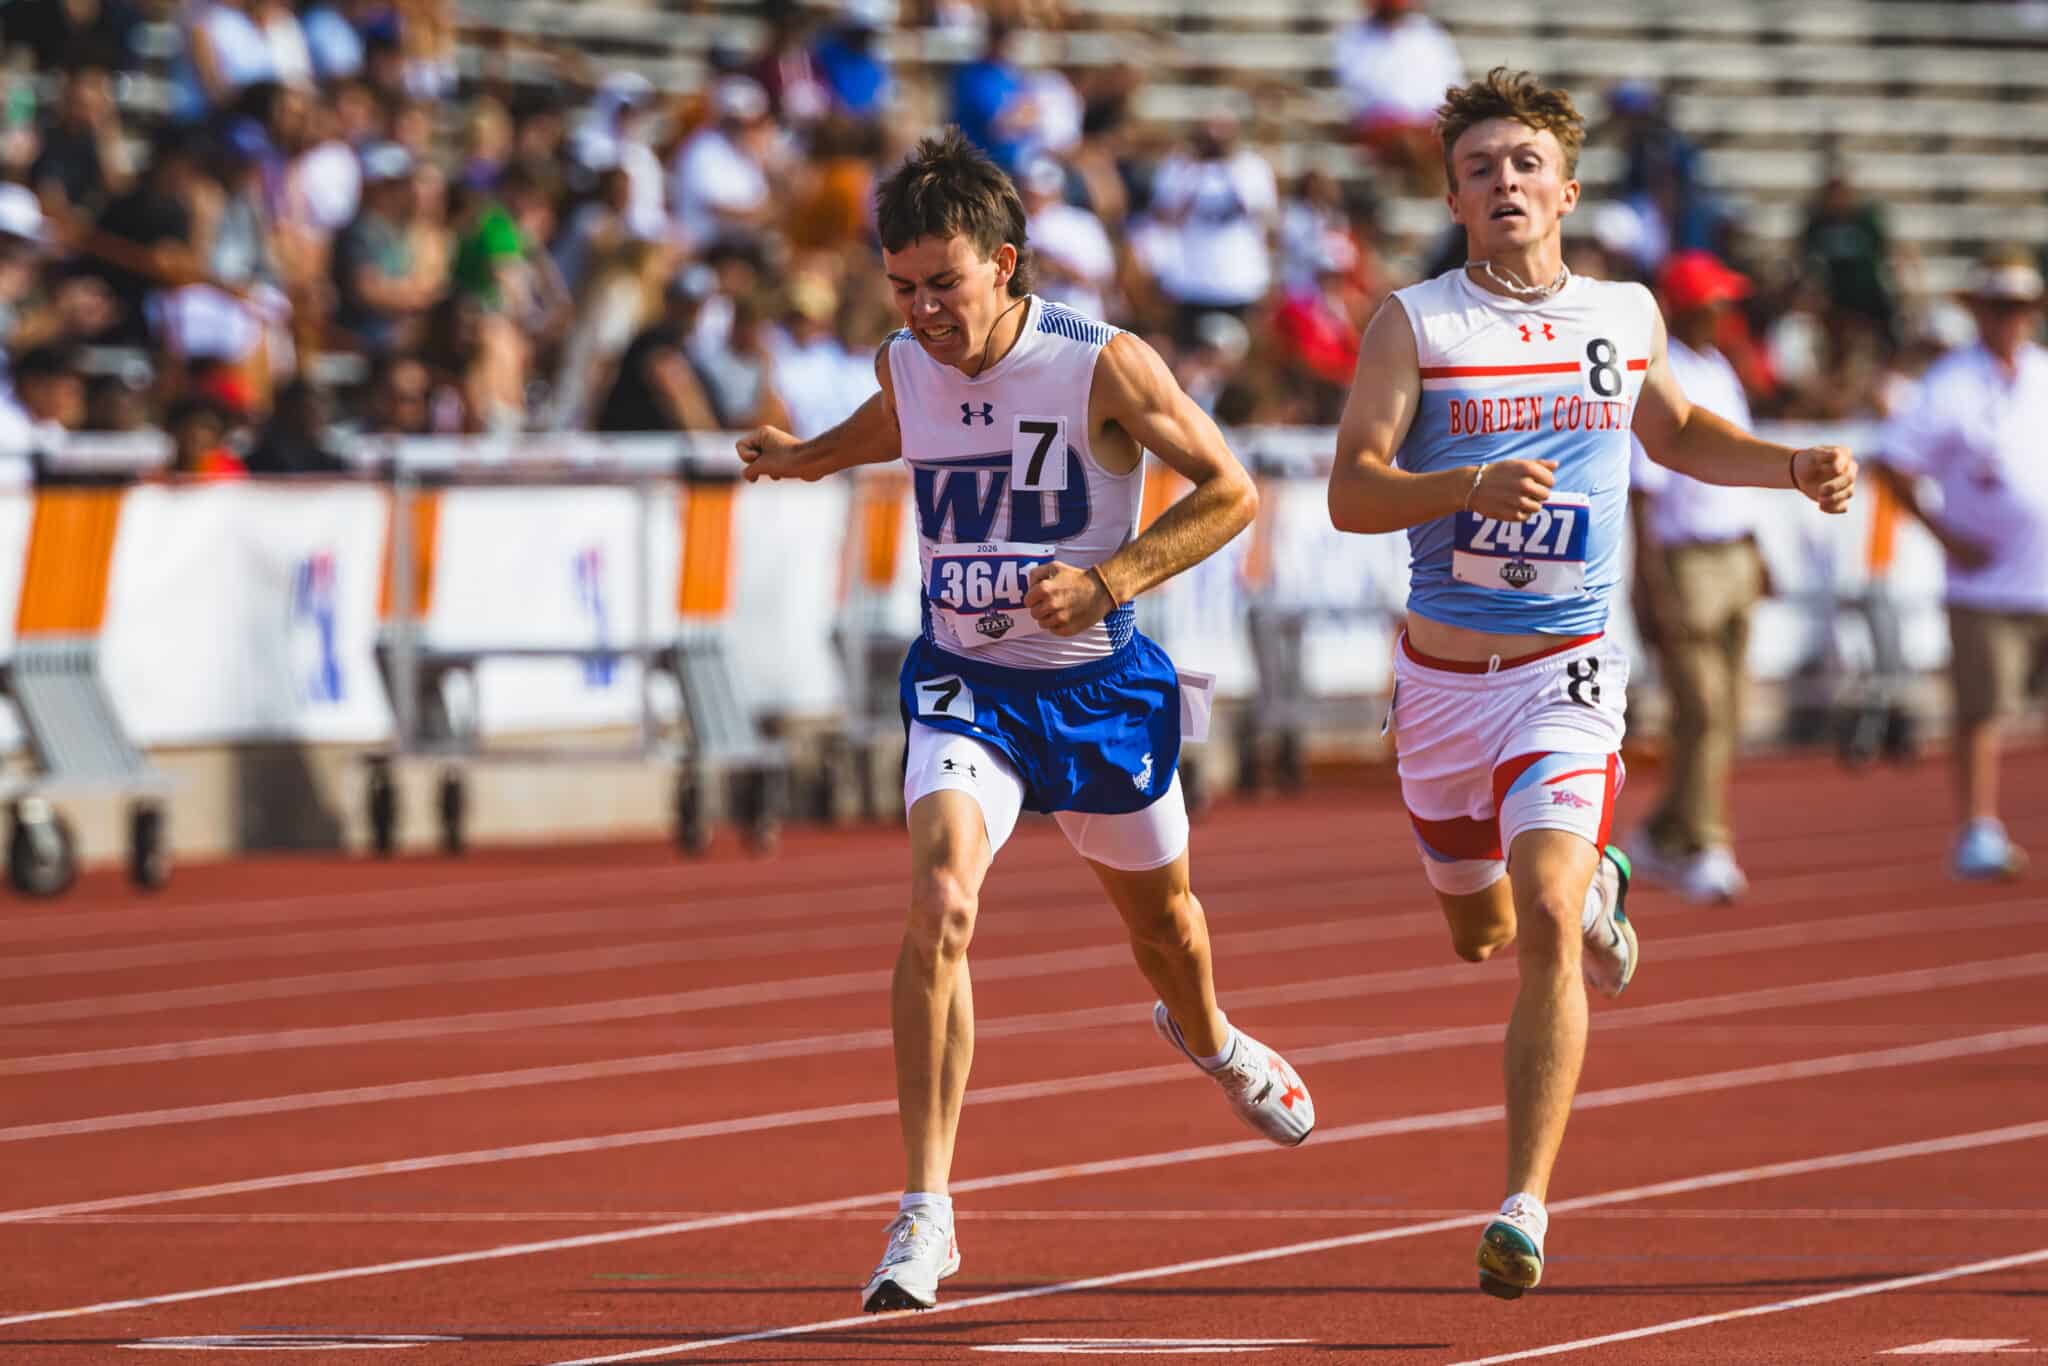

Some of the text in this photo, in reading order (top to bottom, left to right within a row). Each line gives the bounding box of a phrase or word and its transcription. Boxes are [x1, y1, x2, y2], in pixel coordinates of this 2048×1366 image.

[1586, 338, 1622, 397] 8
[1449, 394, 1632, 435] BORDEN COUNT
[1019, 420, 1058, 486] 7
[905, 443, 1092, 545] WD
[977, 545, 998, 553] 2026
[1469, 509, 1575, 555] 2427
[922, 678, 962, 712] 7
[1567, 657, 1601, 709] 8
